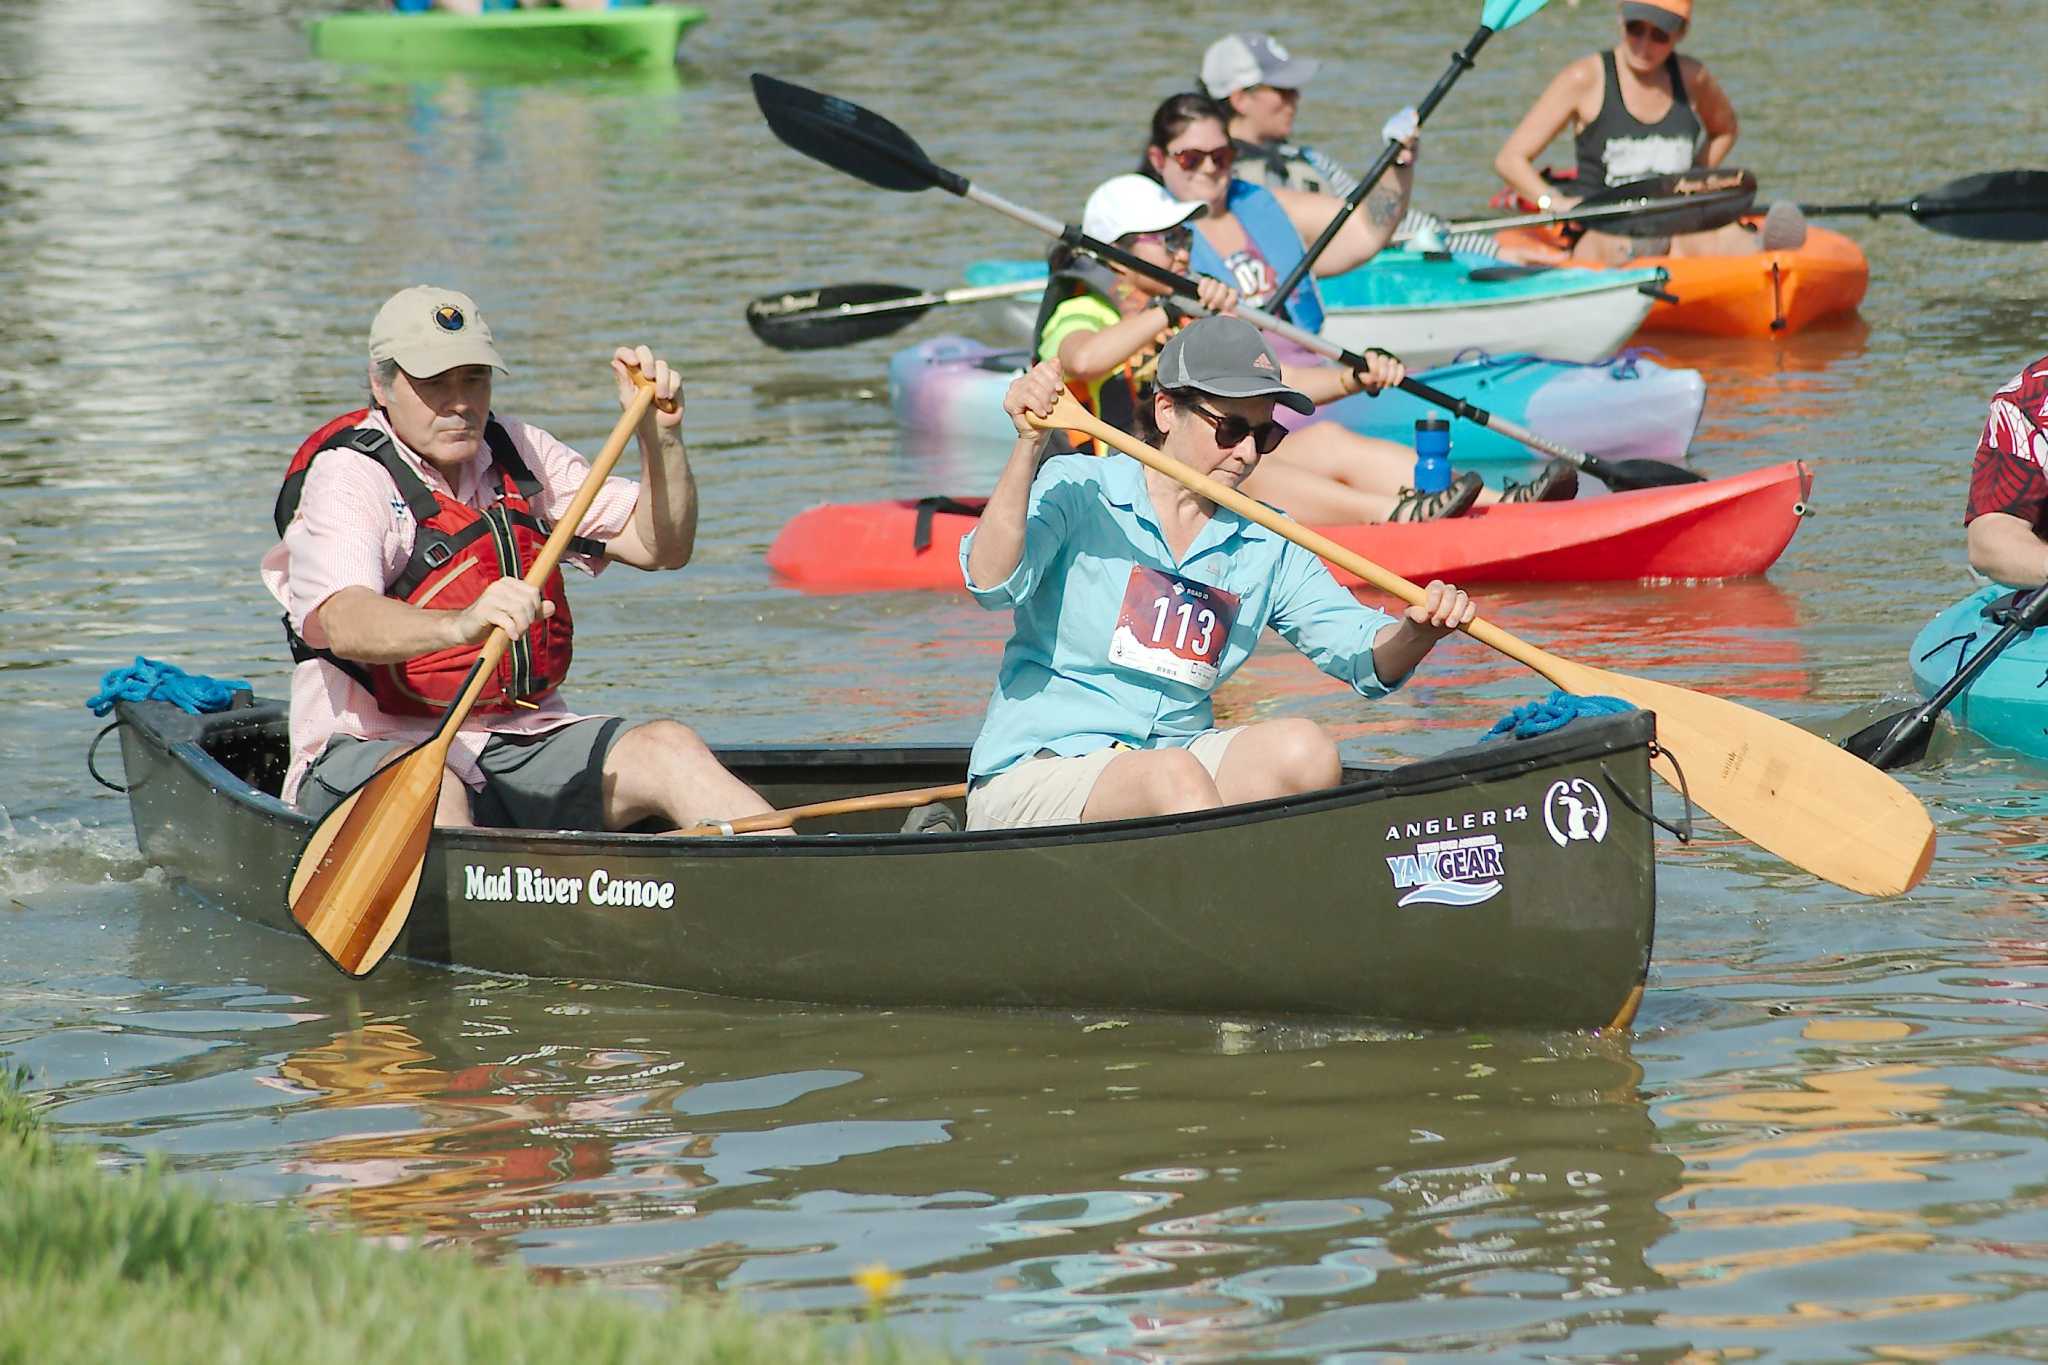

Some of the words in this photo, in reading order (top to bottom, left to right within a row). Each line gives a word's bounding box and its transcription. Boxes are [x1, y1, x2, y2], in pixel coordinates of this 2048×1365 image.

[1151, 596, 1217, 656] 113
[1385, 810, 1497, 841] ANGLER
[1504, 805, 1528, 823] 14
[464, 865, 513, 901] Mad
[515, 866, 583, 904] River
[588, 869, 675, 909] Canoe
[1386, 845, 1505, 889] YAKGEAR
